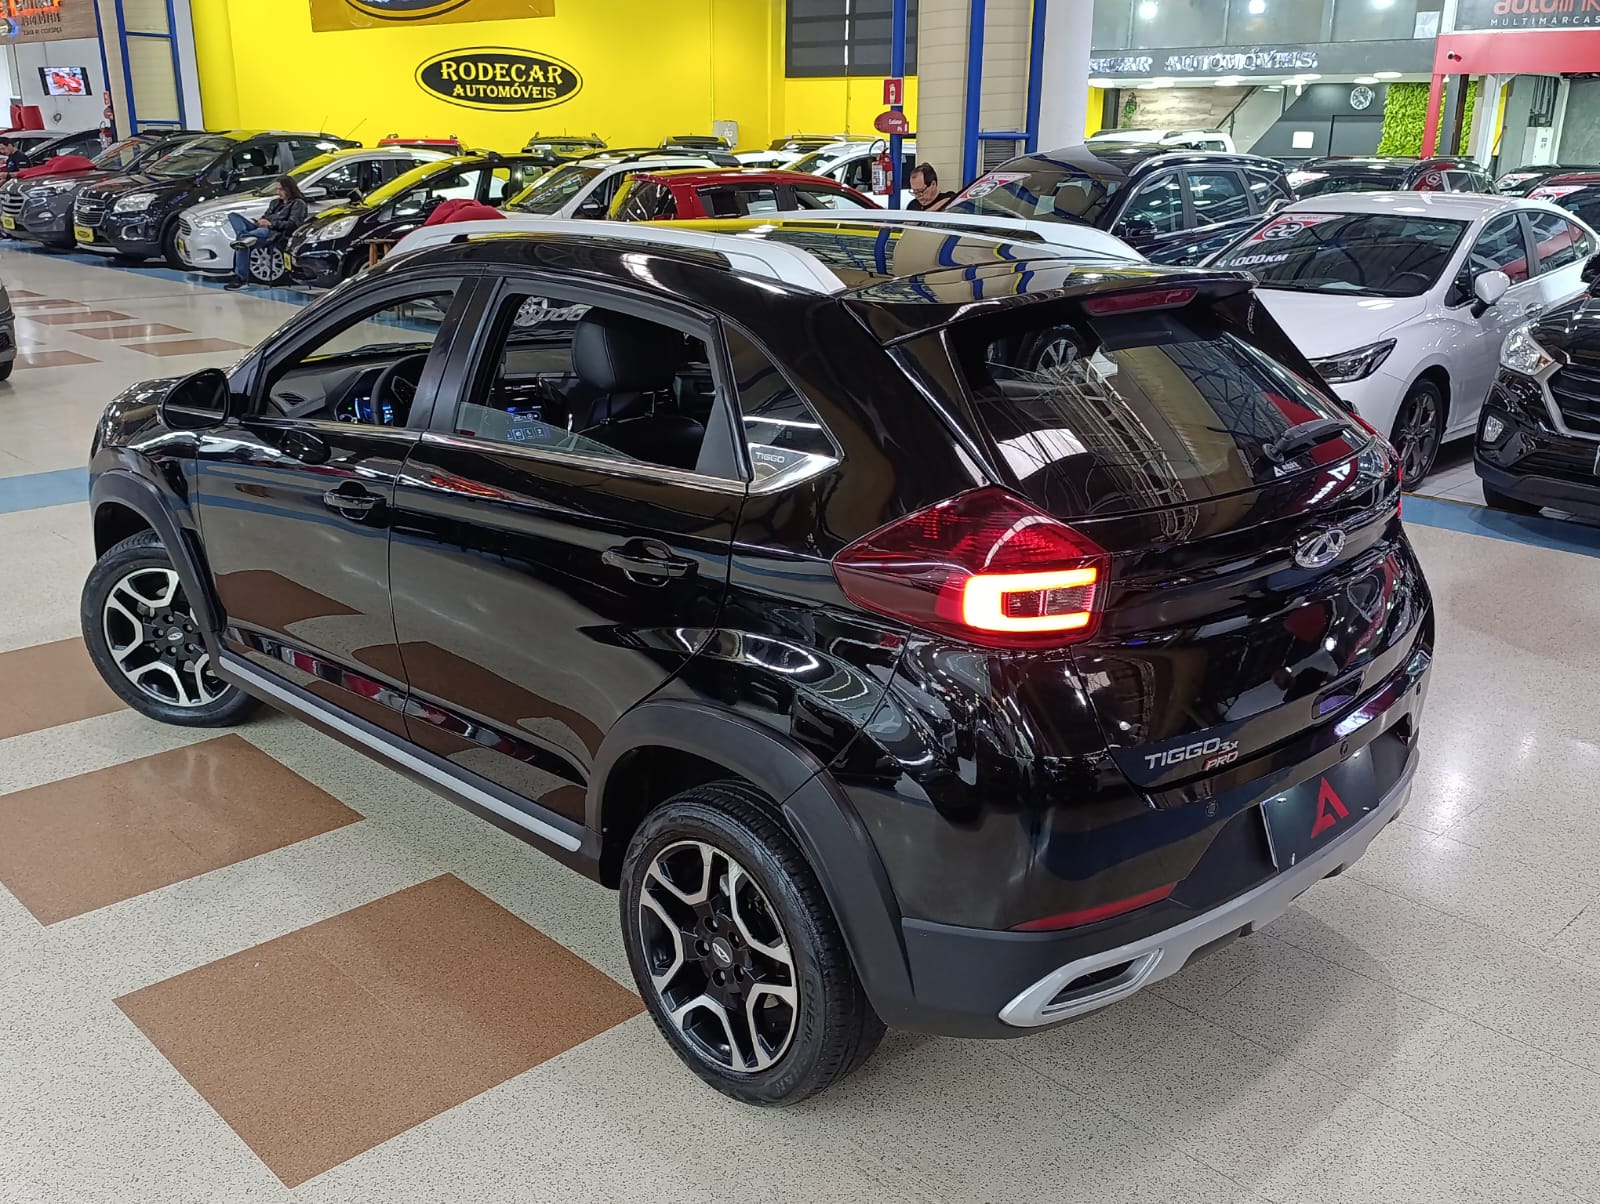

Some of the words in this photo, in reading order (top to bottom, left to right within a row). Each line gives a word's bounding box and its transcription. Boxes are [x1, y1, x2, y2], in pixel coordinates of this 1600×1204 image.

[1490, 15, 1600, 26] MULTIMARCAS
[440, 61, 563, 85] RODECAR
[452, 82, 557, 98] AUTOMÓVEIS
[1265, 224, 1298, 238] 22
[755, 452, 785, 463] TIGGO
[1144, 737, 1221, 770] TIGGO
[1206, 751, 1239, 771] PRO
